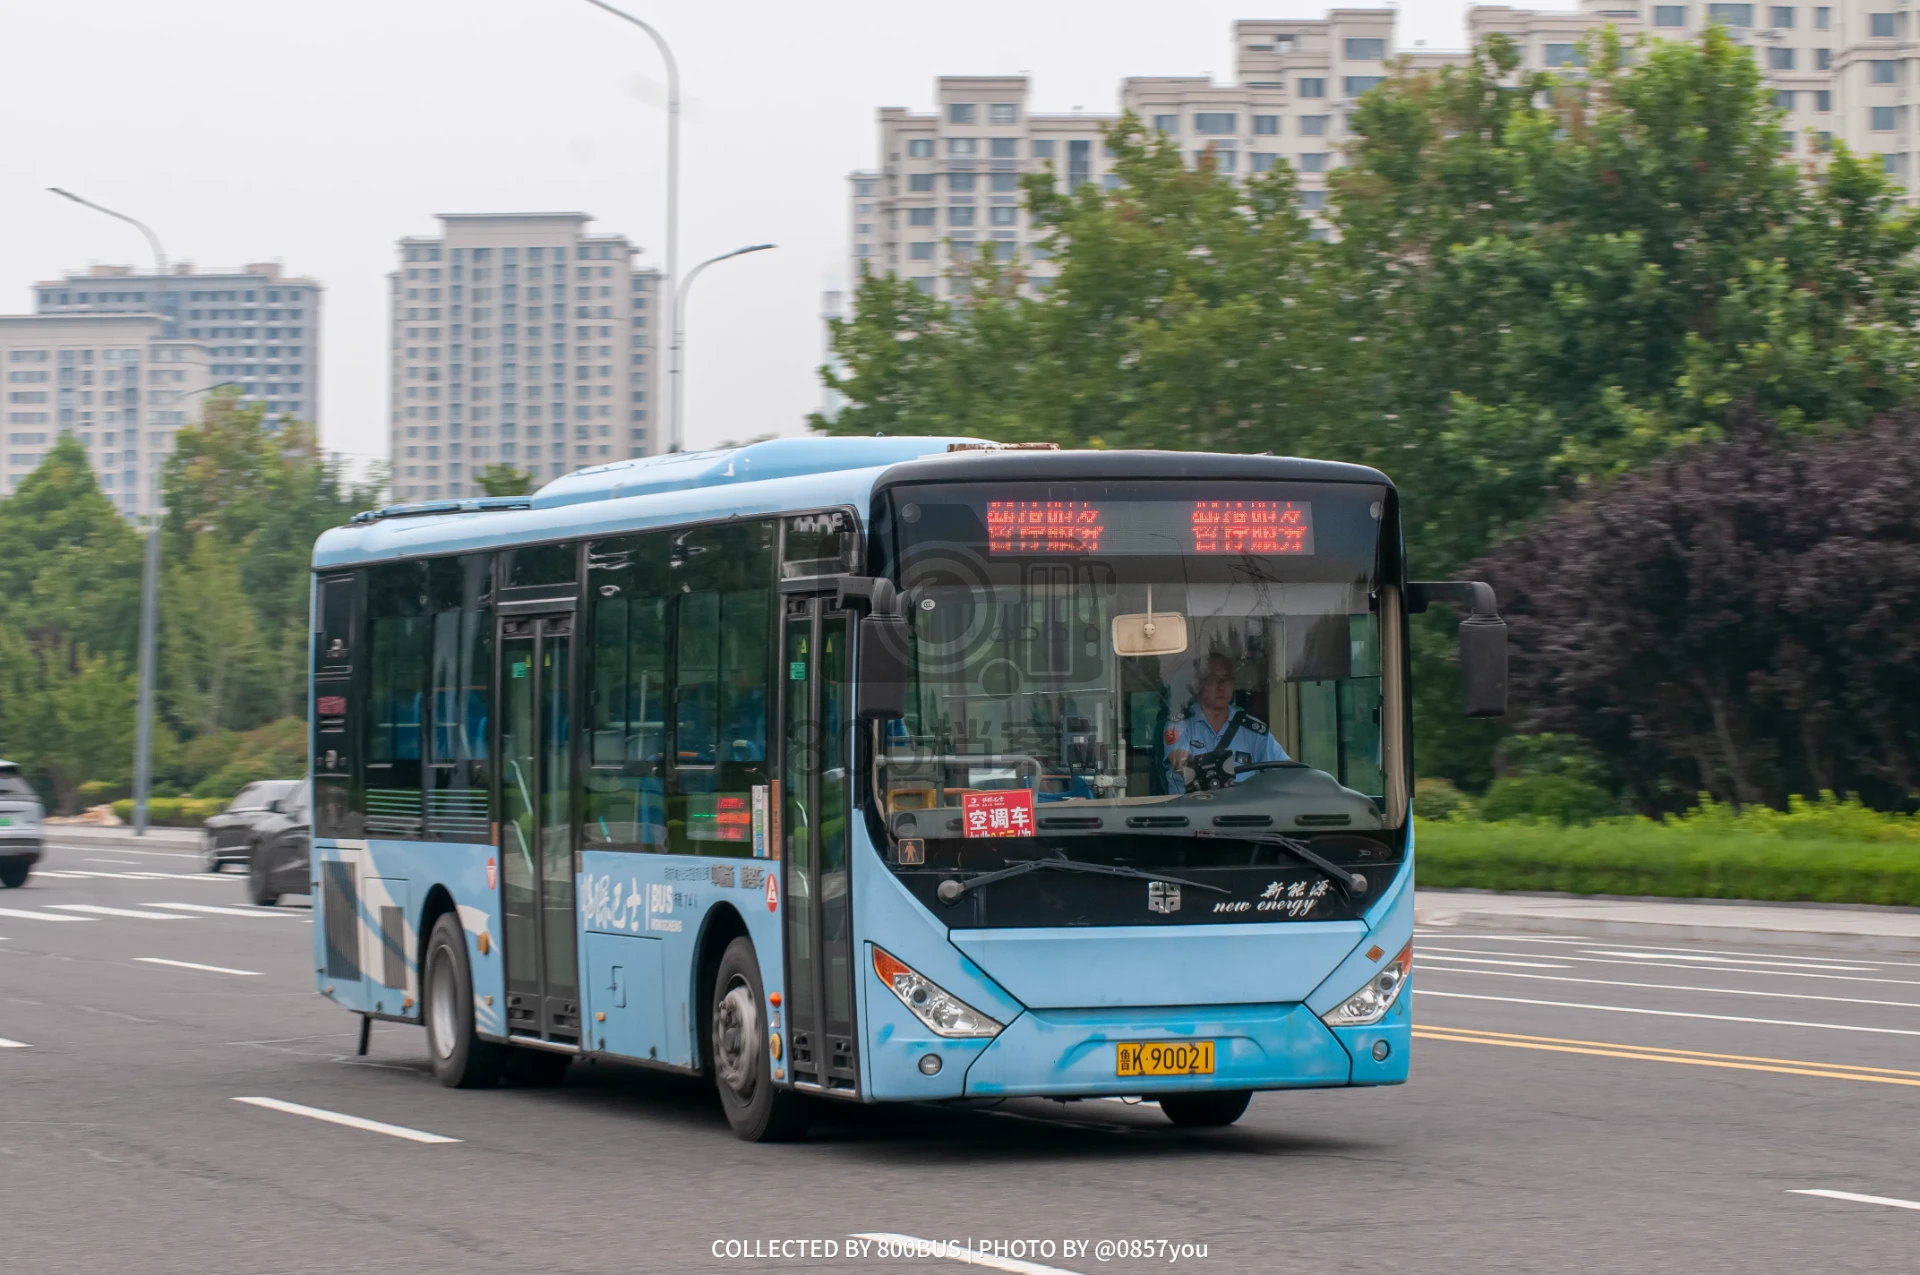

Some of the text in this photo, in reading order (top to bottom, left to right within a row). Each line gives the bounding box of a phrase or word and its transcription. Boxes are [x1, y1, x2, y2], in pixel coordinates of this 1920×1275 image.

[969, 806, 1030, 831] 空调车
[651, 884, 673, 914] BUS
[1260, 880, 1329, 900] 新能源
[1213, 899, 1318, 917] new energy
